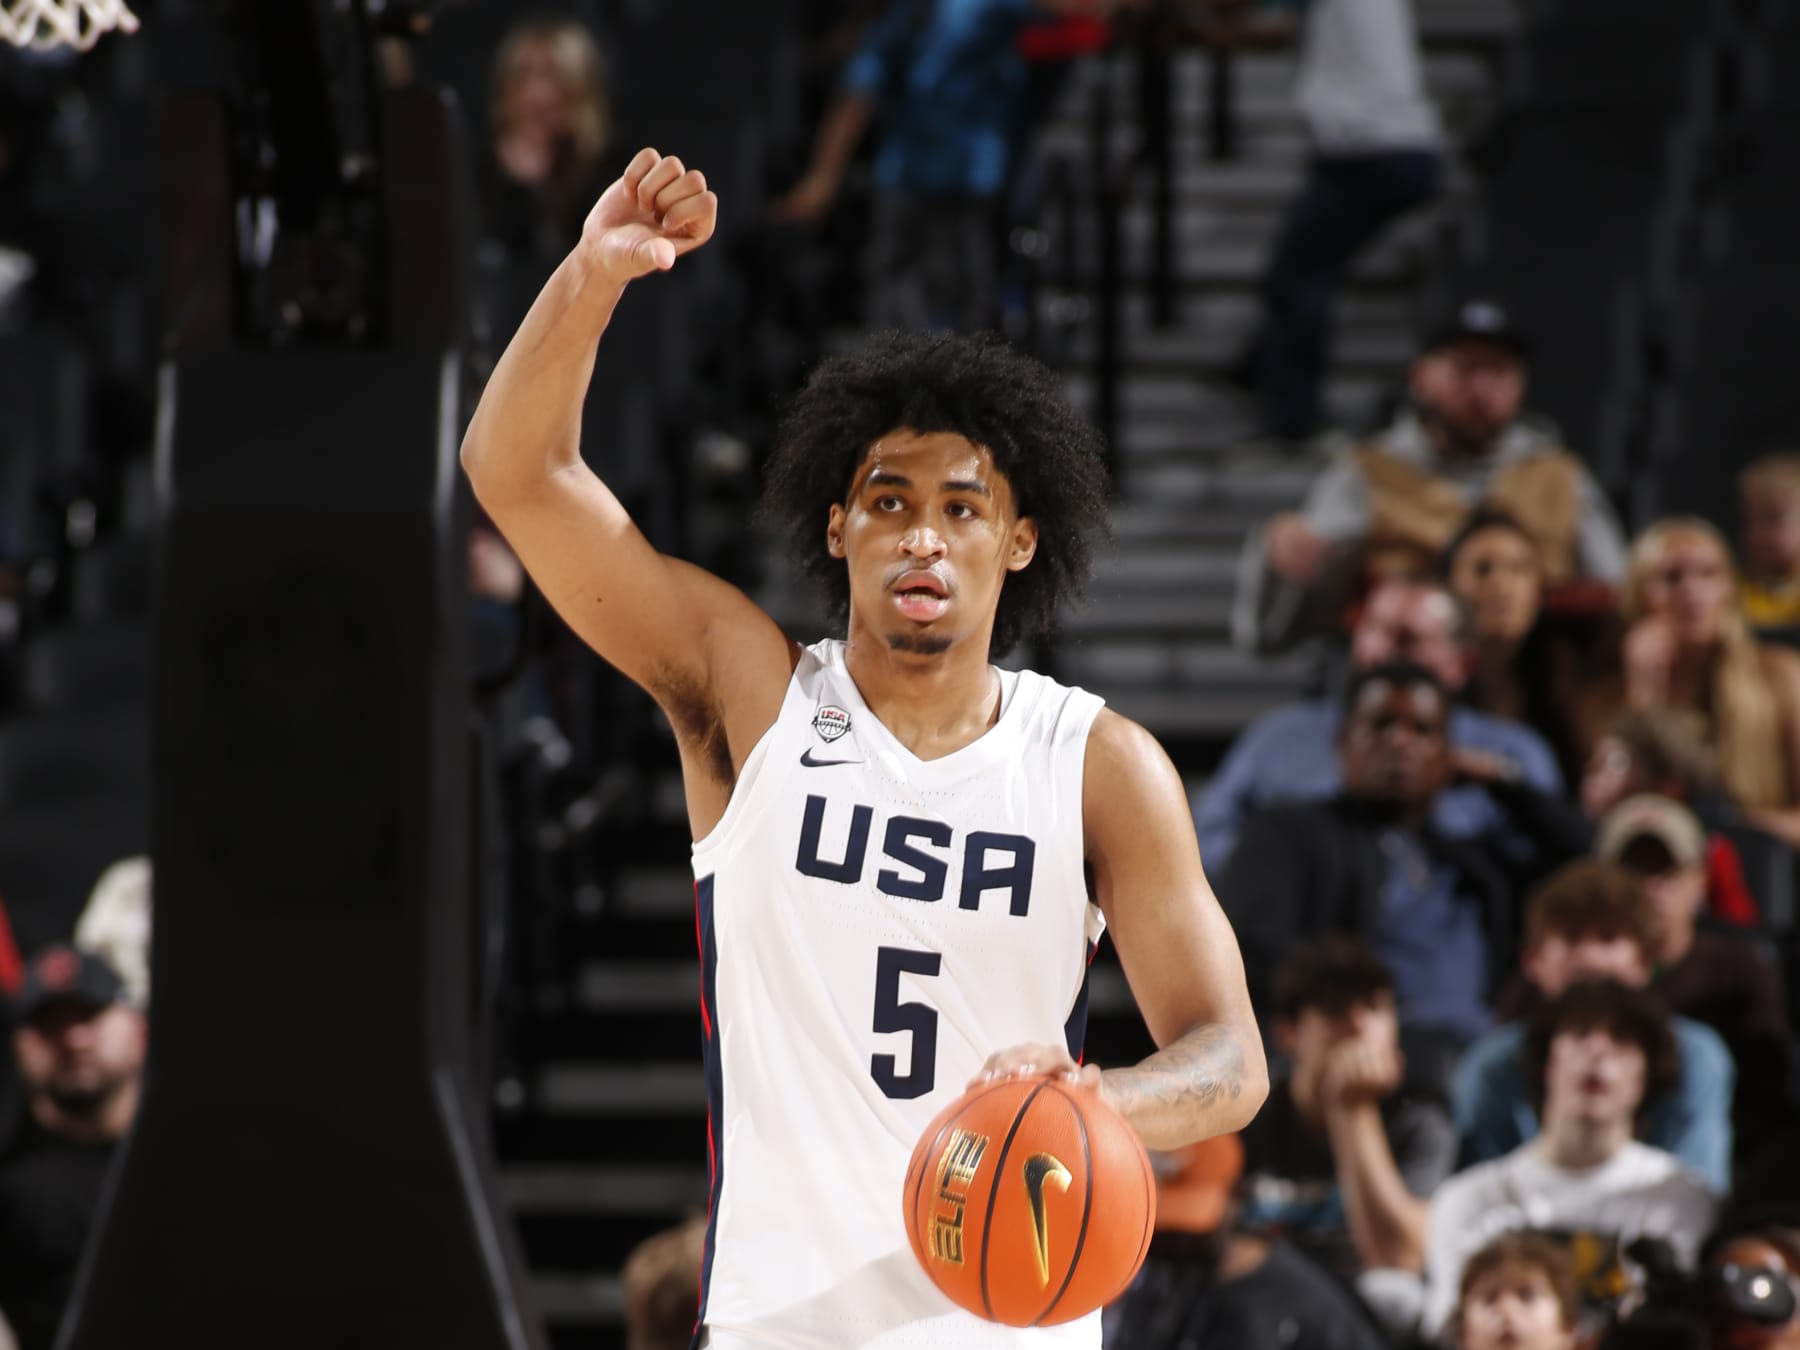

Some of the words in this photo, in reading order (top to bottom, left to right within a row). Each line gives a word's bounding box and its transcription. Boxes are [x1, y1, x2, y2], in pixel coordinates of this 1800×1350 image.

[821, 709, 845, 723] USA
[796, 794, 1036, 917] USA
[870, 945, 942, 1099] 5
[928, 1128, 990, 1265] ELITE
